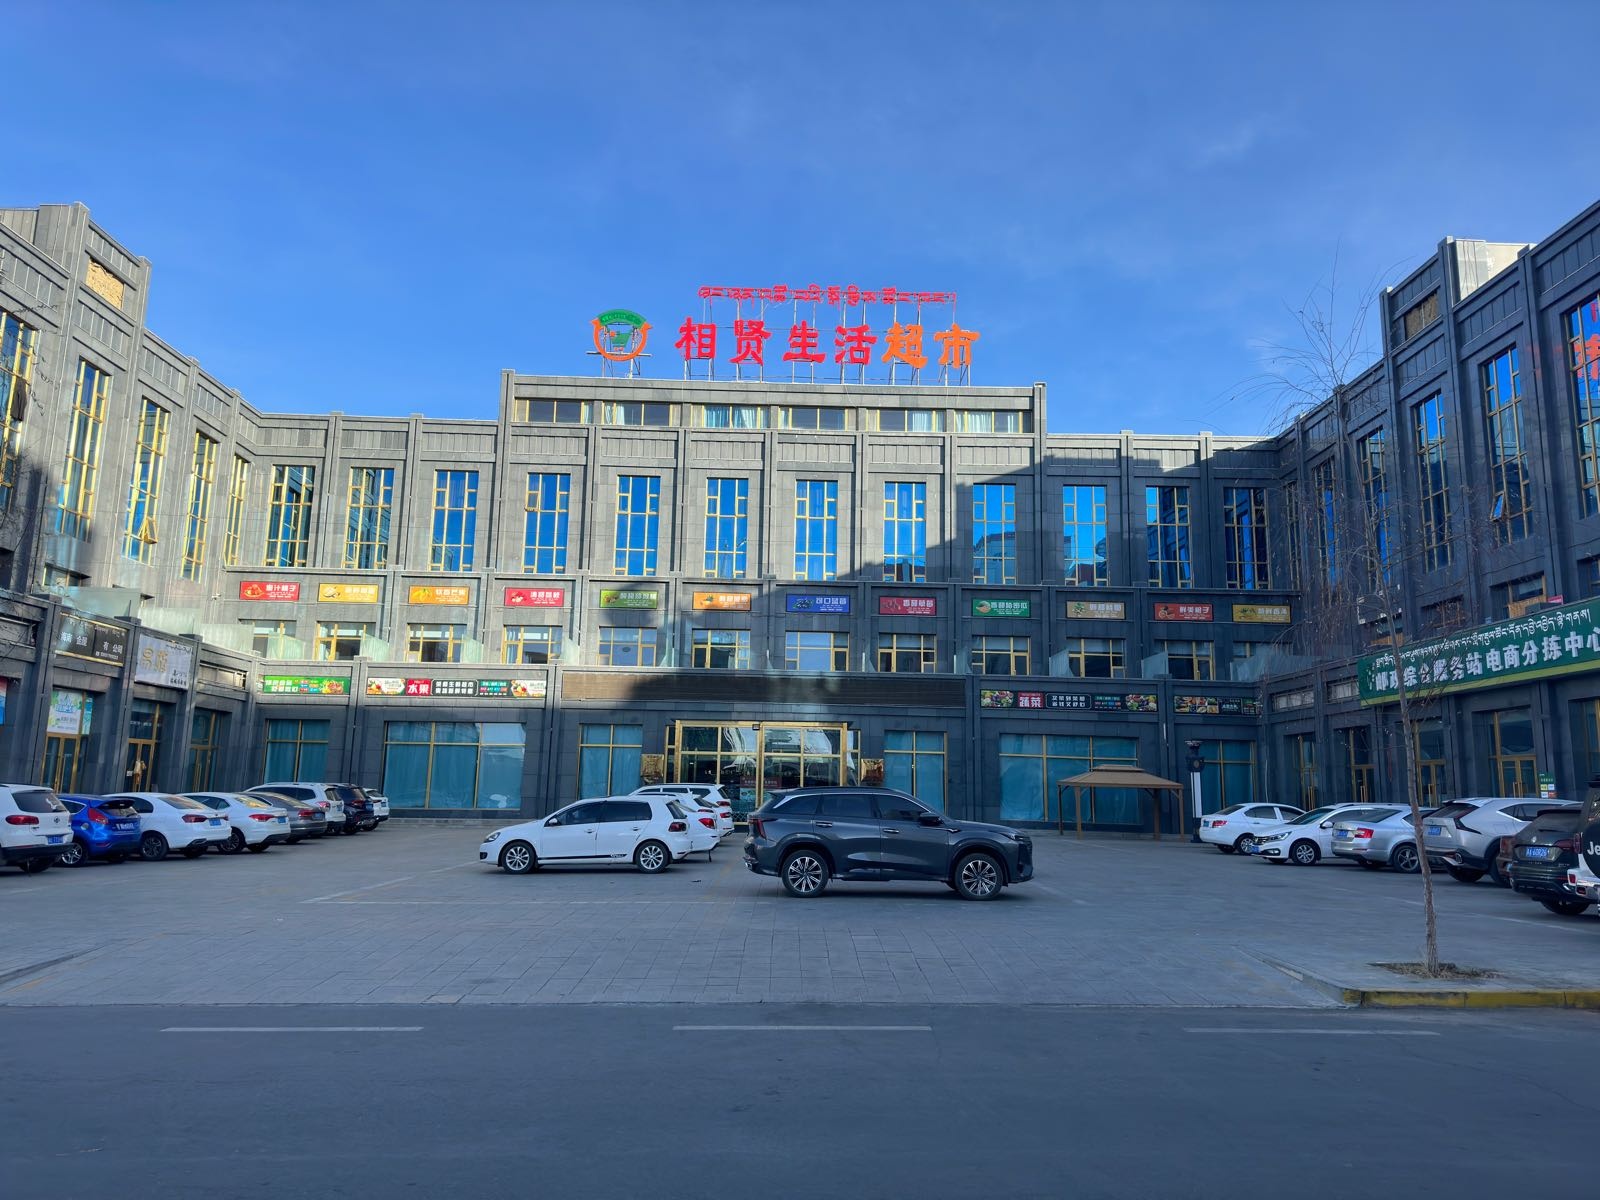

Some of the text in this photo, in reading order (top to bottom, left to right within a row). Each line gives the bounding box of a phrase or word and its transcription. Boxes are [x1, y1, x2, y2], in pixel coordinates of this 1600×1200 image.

[675, 316, 980, 368] 相贤生活超市
[1375, 627, 1600, 692] 邮政综合服务站电商分拣中心
[407, 683, 430, 694] 水果
[1019, 697, 1042, 708] 蔬菜
